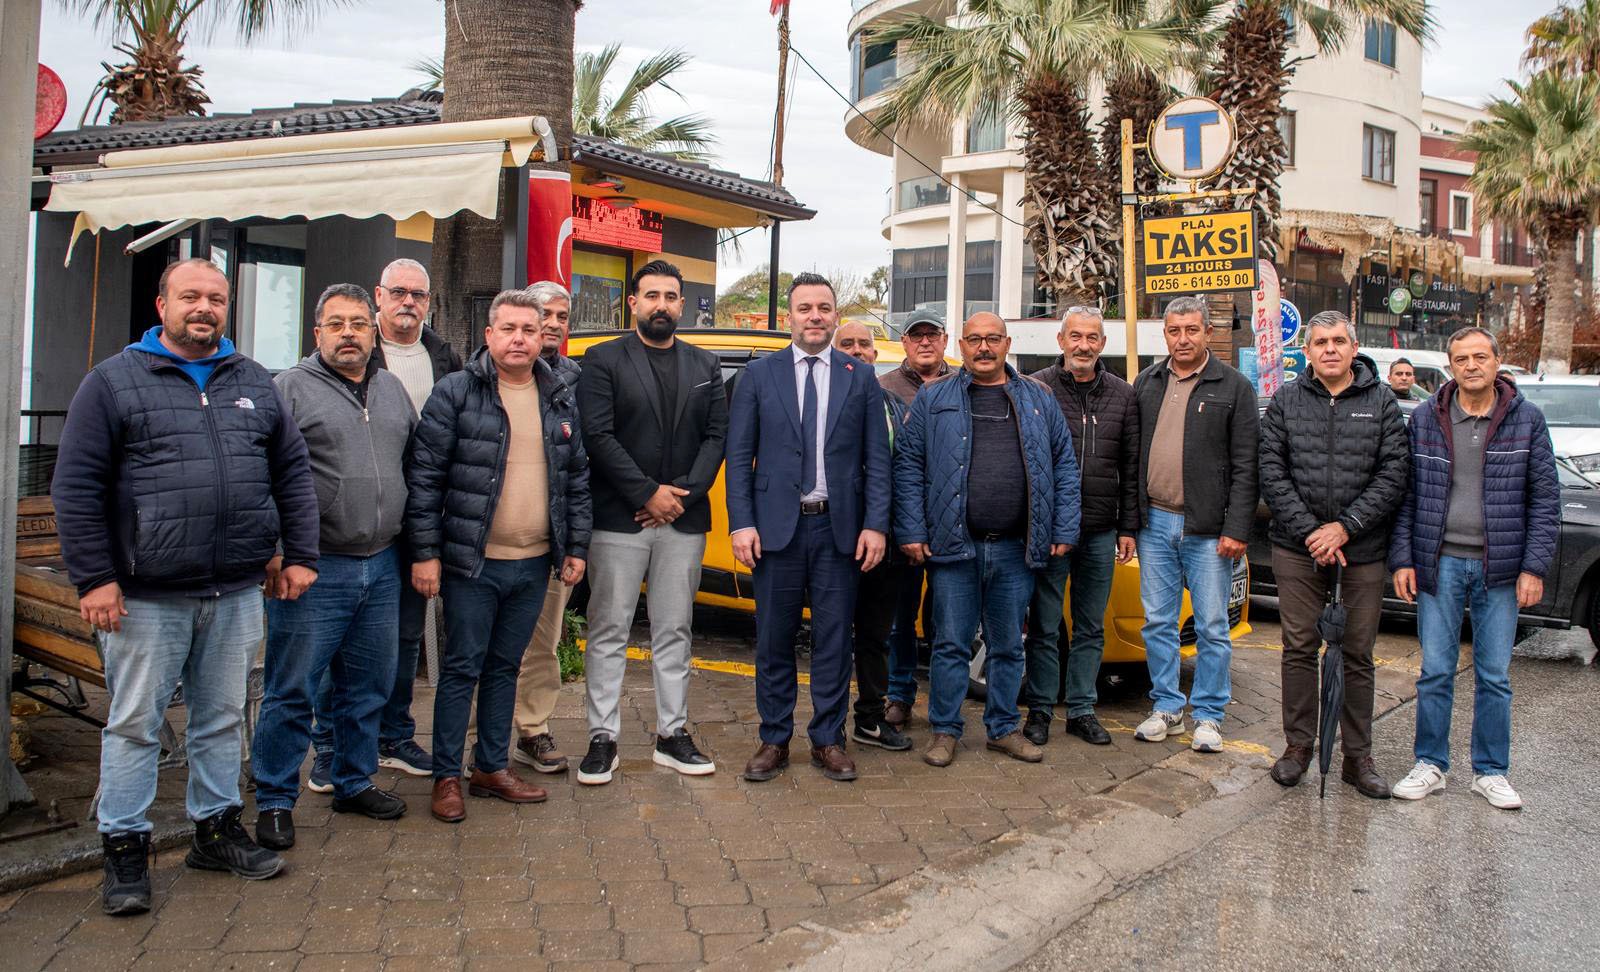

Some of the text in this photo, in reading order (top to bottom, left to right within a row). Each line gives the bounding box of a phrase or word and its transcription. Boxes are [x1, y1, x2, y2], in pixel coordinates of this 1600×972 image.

[1165, 110, 1220, 171] T
[1181, 219, 1214, 230] PLAJ
[1166, 260, 1233, 274] 24 HOURS
[1151, 277, 1179, 291] 0256
[1191, 275, 1212, 288] 614
[1216, 274, 1231, 287] 59
[1234, 273, 1249, 285] 00
[1366, 274, 1387, 285] FAST
